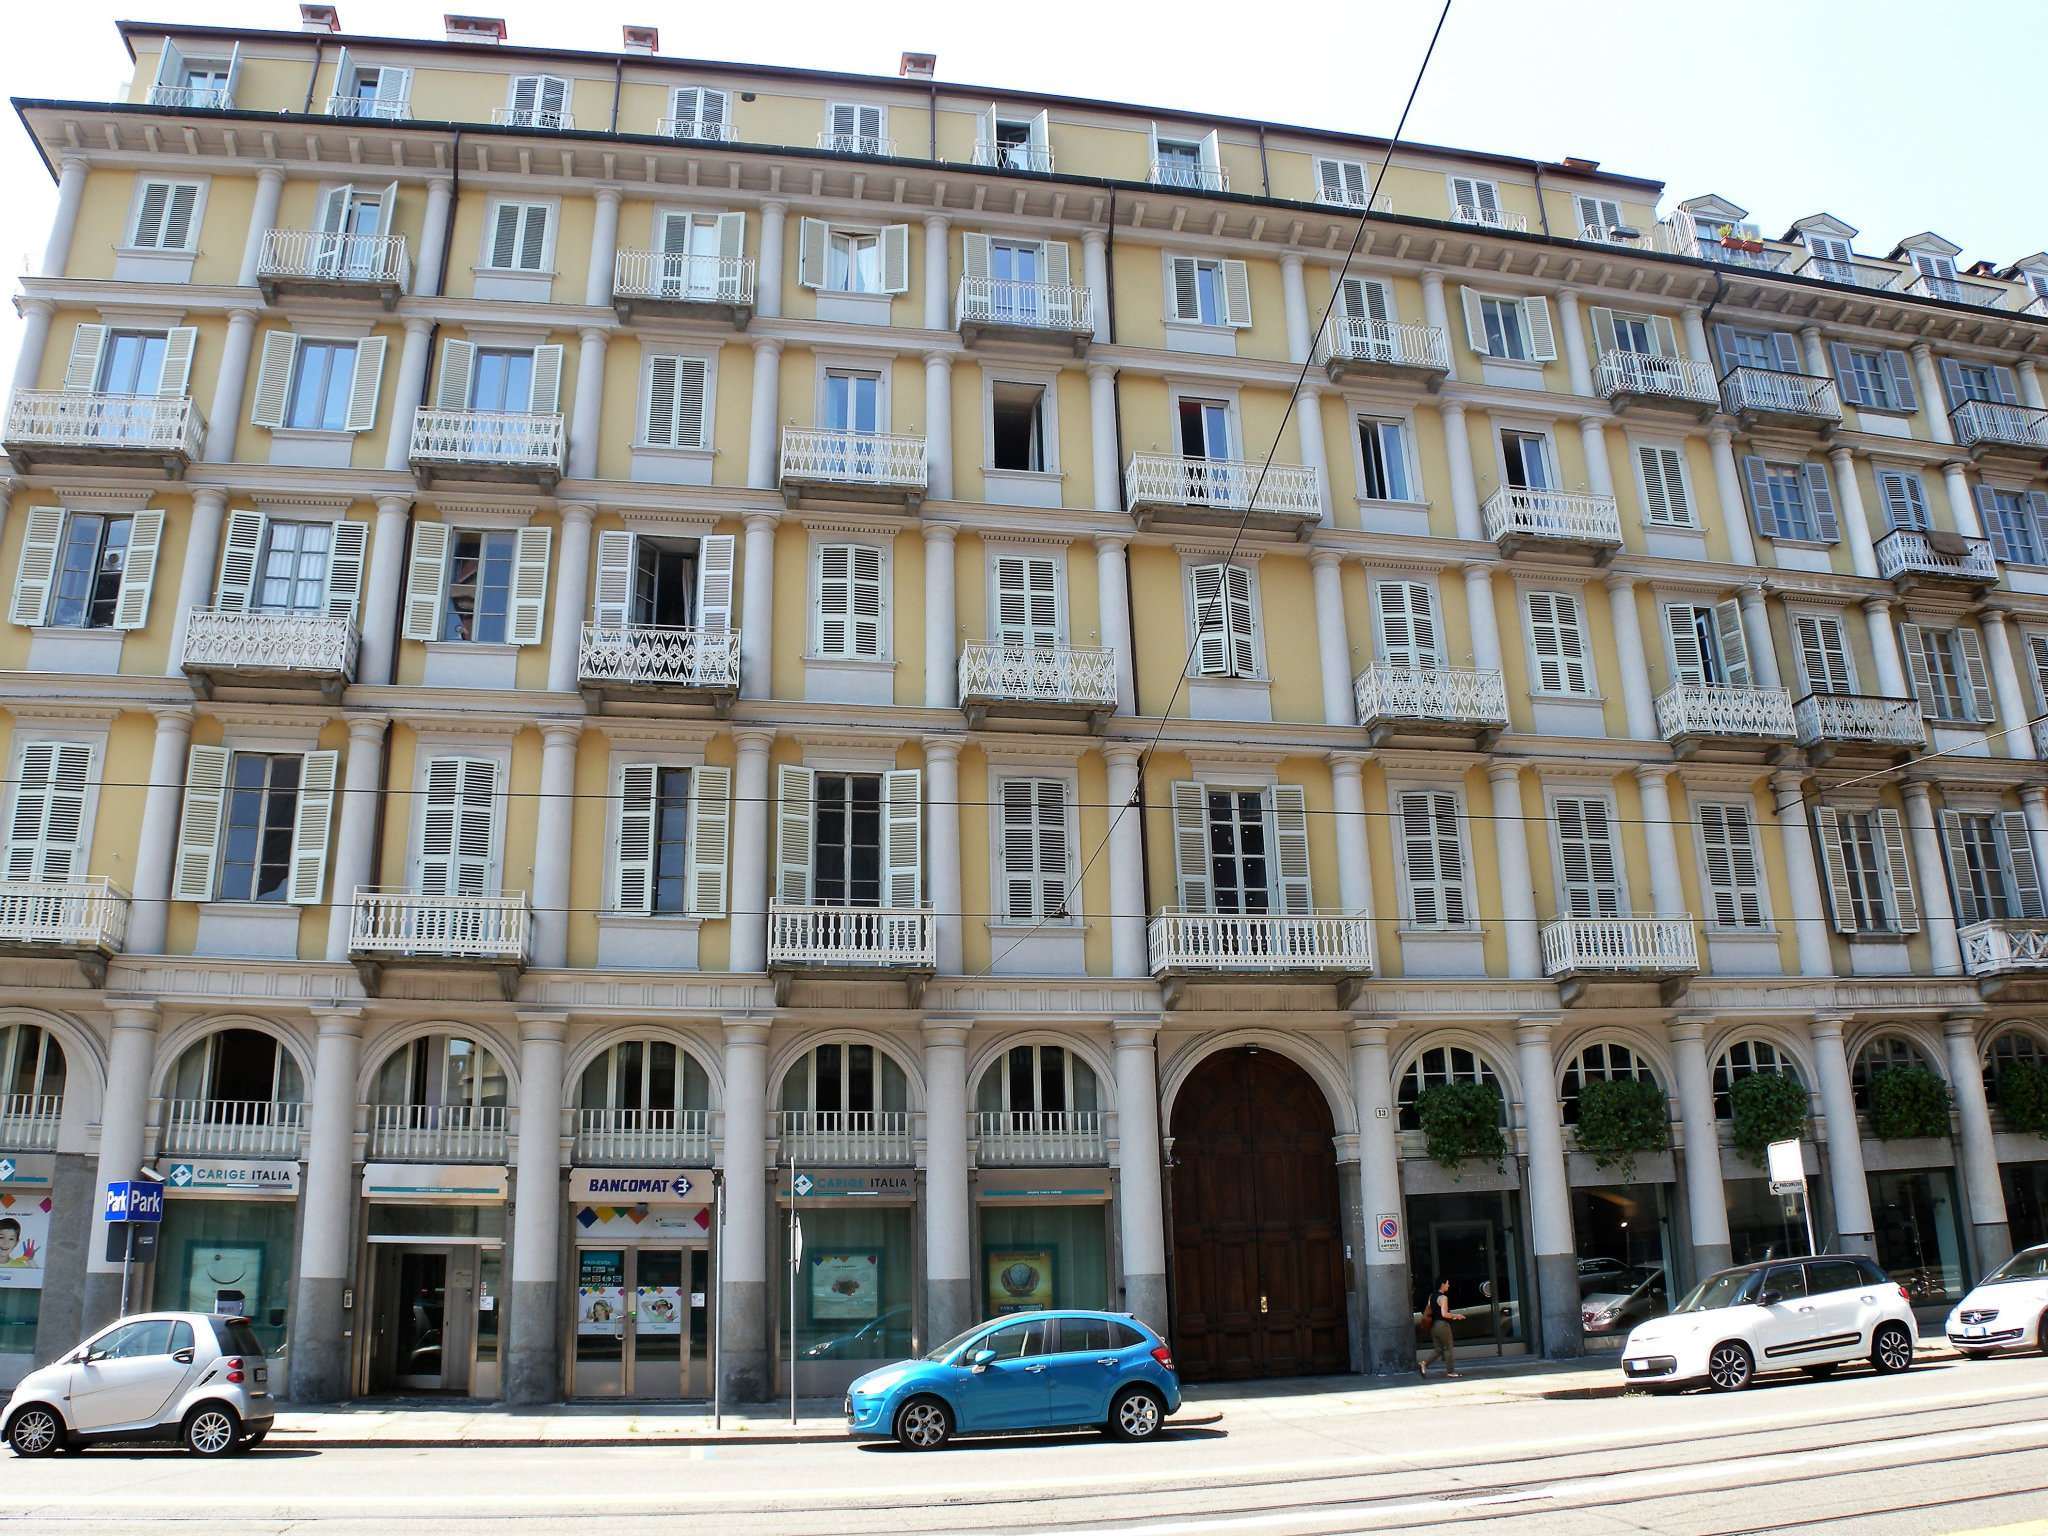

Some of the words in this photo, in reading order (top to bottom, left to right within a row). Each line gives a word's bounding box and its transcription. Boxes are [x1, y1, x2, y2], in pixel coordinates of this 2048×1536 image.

[197, 1168, 246, 1180] CARIGE
[251, 1170, 290, 1181] ITALIA
[589, 1179, 669, 1193] BANCOMAT
[870, 1178, 907, 1188] ITALIA
[106, 1190, 127, 1212] Park
[130, 1189, 161, 1213] Park
